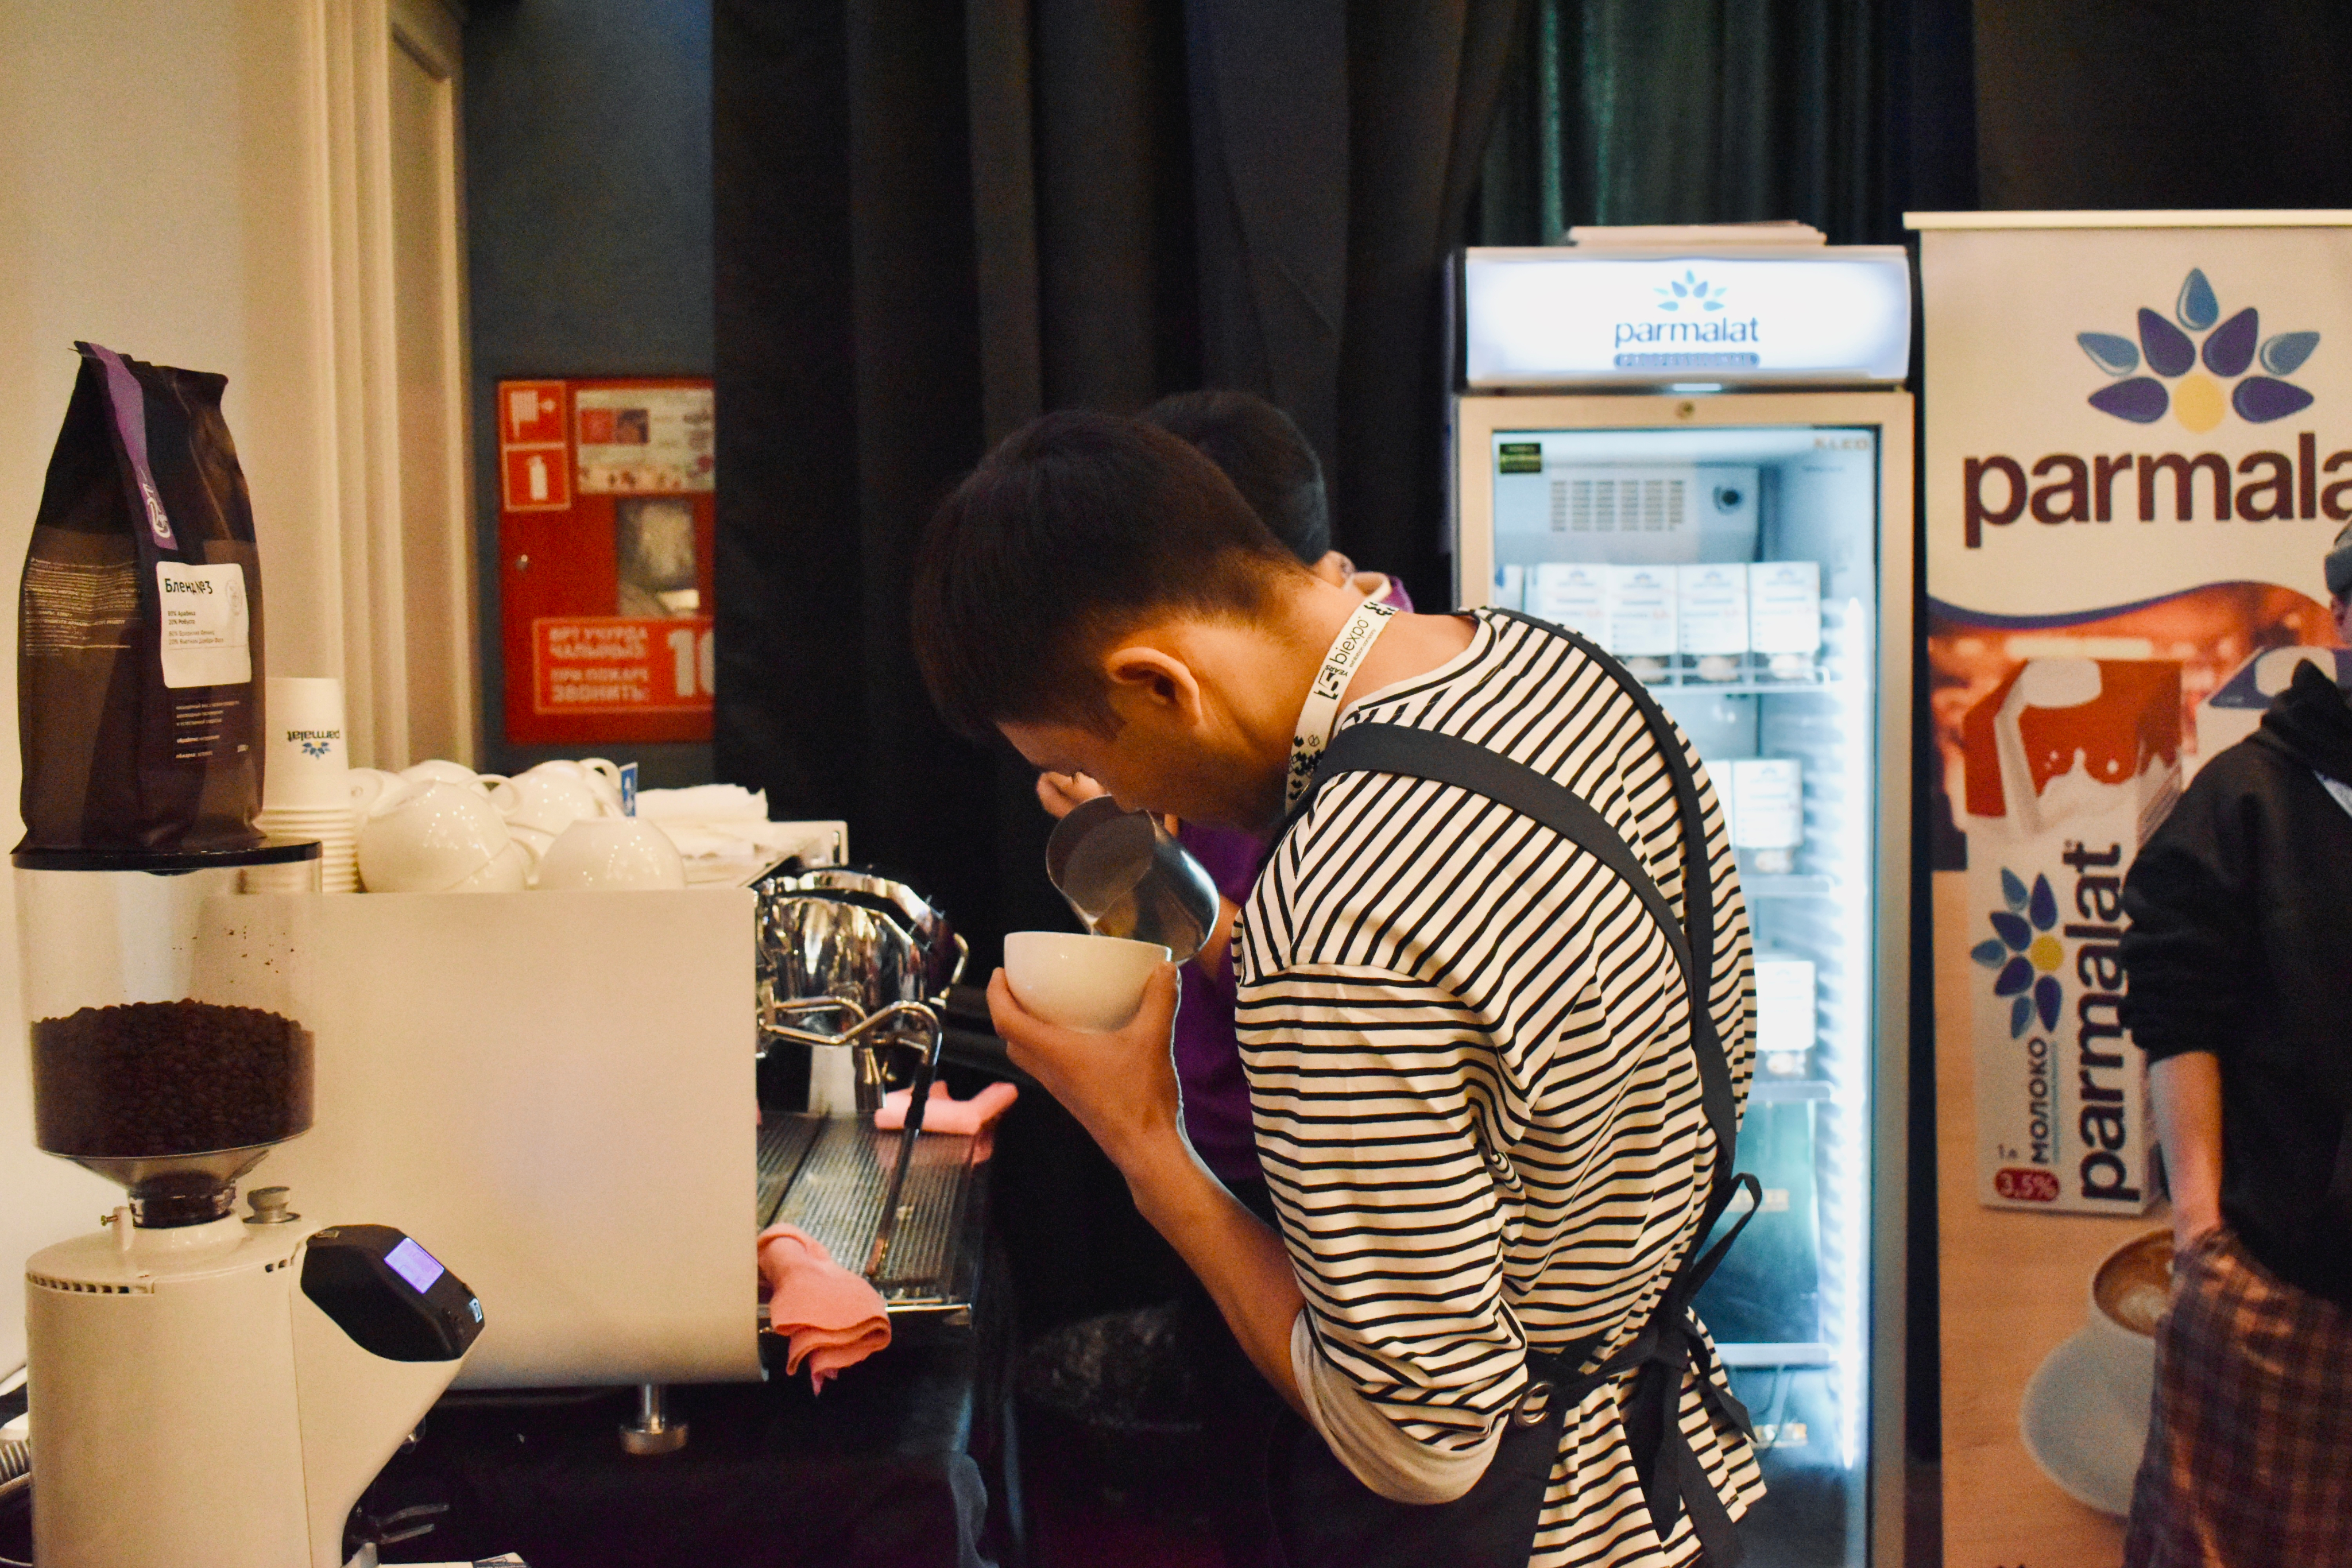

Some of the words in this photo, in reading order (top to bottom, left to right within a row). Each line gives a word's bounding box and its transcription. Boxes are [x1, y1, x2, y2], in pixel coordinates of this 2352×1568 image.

[1614, 316, 1759, 349] parmalat
[1329, 619, 1369, 665] biexpo
[1325, 664, 1349, 677] YEARS
[287, 729, 340, 742] parmalat
[2063, 840, 2140, 1201] parmalat
[2027, 1037, 2050, 1164] МОЛОКО
